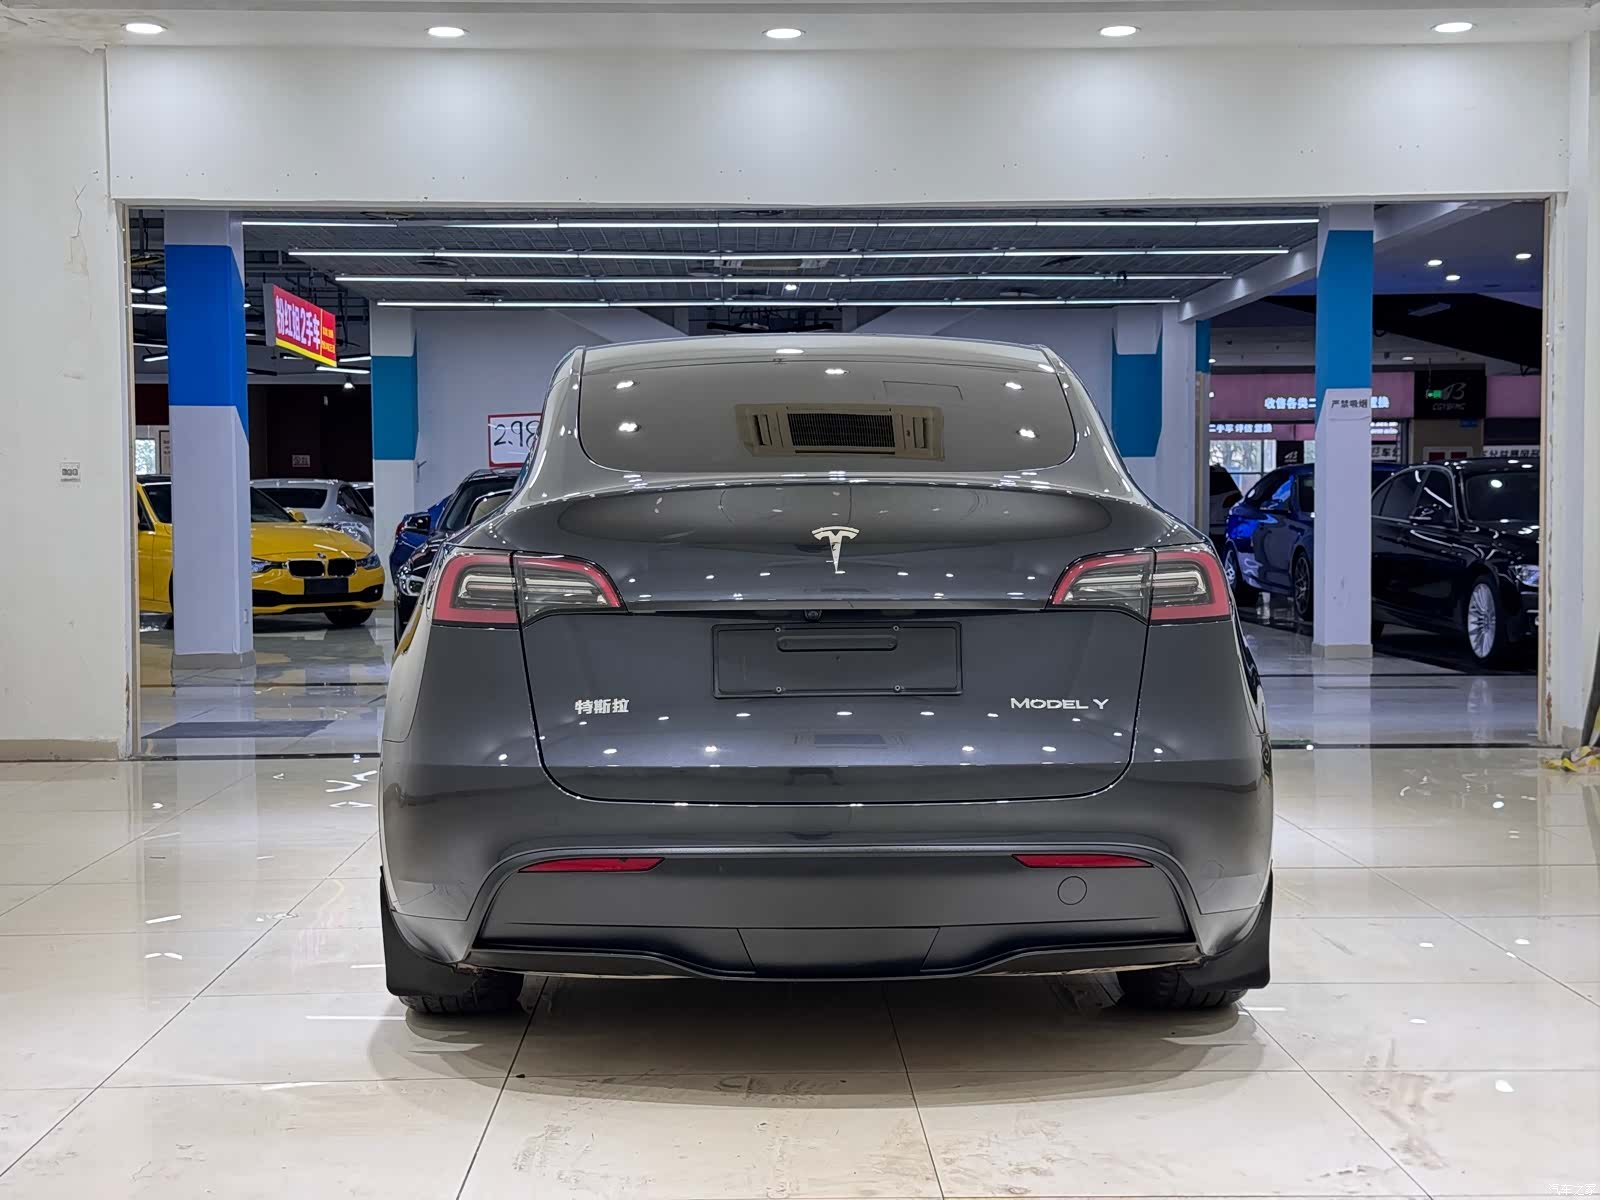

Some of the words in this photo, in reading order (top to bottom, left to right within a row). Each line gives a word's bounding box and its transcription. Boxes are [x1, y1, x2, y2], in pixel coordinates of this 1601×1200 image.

[275, 295, 321, 350] 粉红姐2手车
[1331, 398, 1368, 408] 严禁吸烟
[574, 698, 630, 715] 特斯拉
[1010, 697, 1089, 710] MODEL
[1092, 698, 1109, 710] Y
